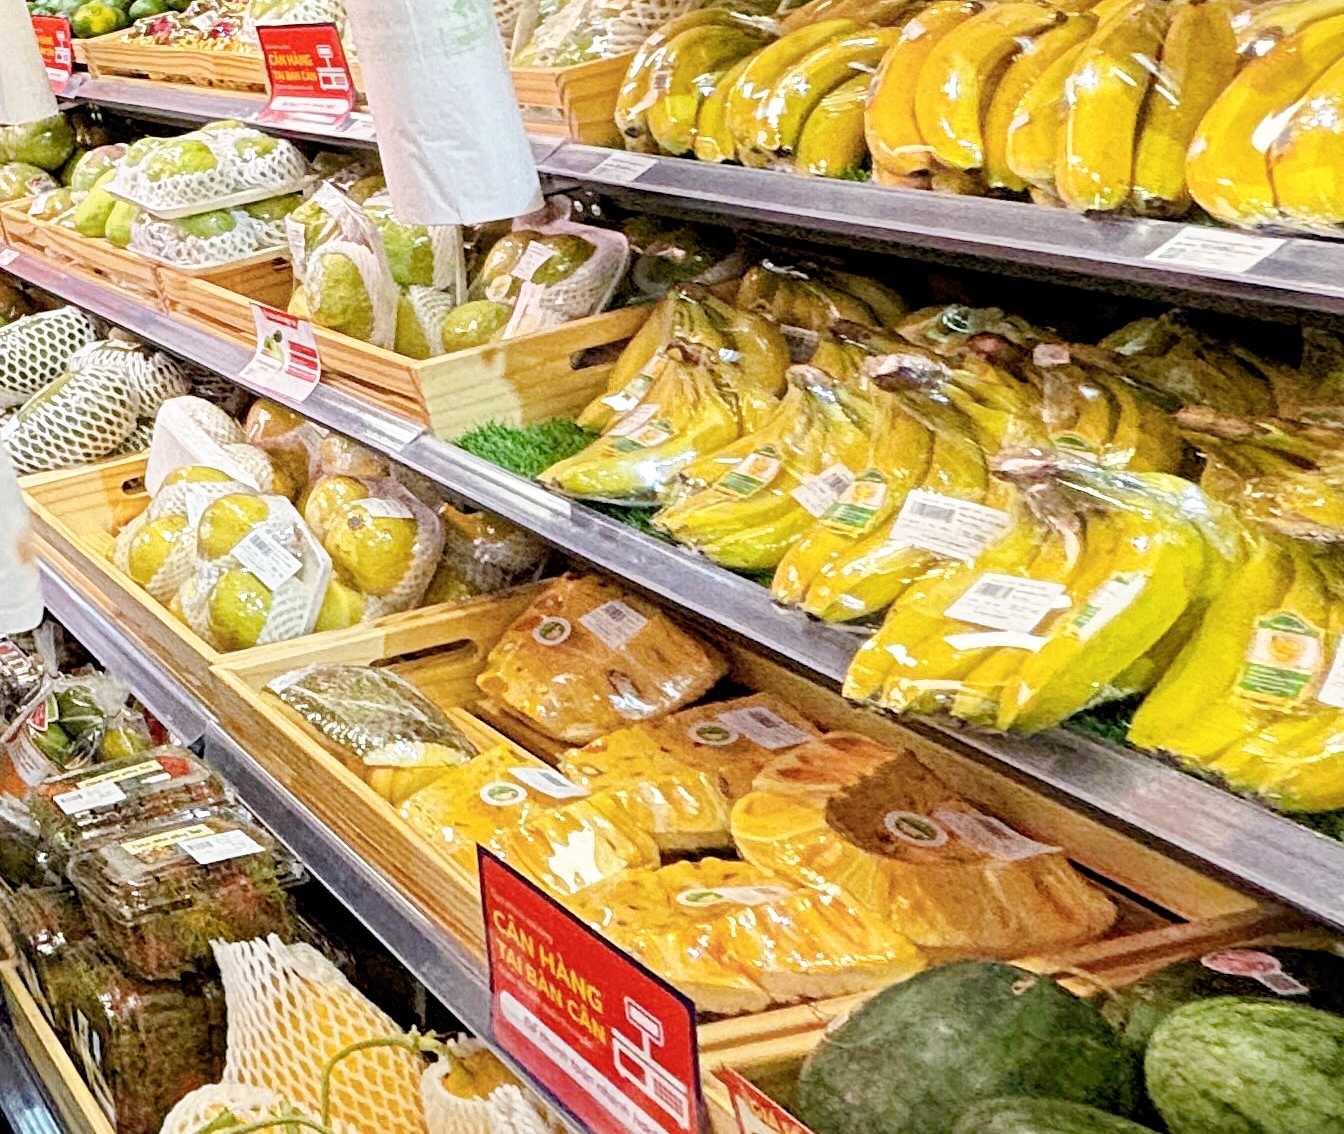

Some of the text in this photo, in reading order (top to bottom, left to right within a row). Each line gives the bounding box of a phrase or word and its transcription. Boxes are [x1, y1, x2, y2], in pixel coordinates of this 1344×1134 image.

[493, 909, 535, 959] CÂN
[539, 944, 604, 1015] HÀNG
[525, 963, 563, 1008] BÀN
[566, 998, 606, 1044] CÂN
